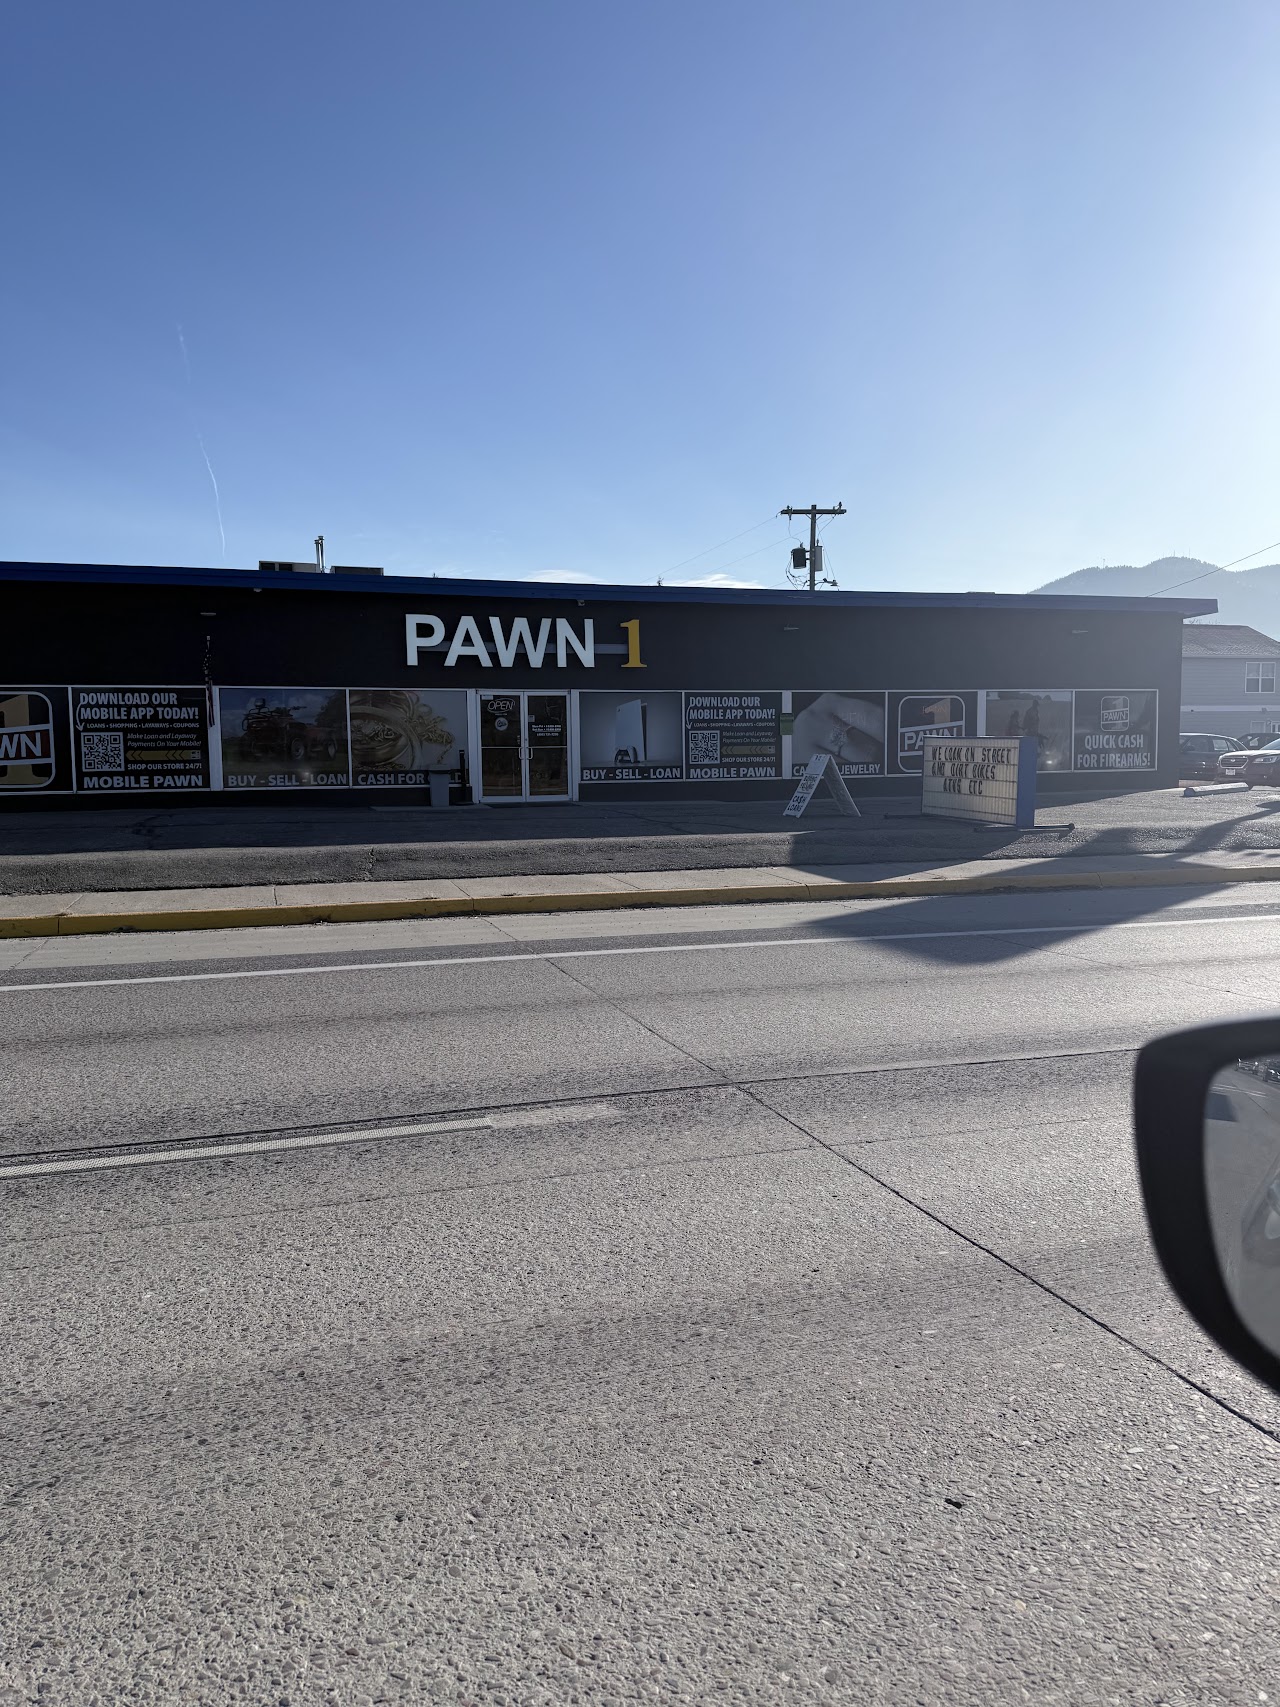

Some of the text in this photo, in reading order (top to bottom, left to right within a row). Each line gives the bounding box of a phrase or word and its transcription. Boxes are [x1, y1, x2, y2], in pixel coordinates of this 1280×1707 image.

[405, 613, 648, 669] PAWN 1
[79, 692, 178, 705] DOWNLOAD OUR
[488, 700, 514, 710] OPEN
[689, 696, 761, 707] DOWNLOAD OUR
[80, 706, 199, 720] MOBILE APP TODAY!
[689, 708, 776, 720] MOBILE APP TODAY!
[1103, 711, 1126, 721] PAWN
[1084, 734, 1144, 751] QUICK CASH
[931, 747, 1011, 763] WE LOAN ON STREET
[1077, 753, 1151, 768] FOR FIREARMS!
[582, 769, 607, 780] BUY
[615, 768, 642, 779] SELL
[650, 767, 681, 778] LOAN
[689, 767, 776, 779] MOBILE PAWN
[841, 763, 881, 775] JEWELRY
[931, 762, 996, 779] AND DIRT BIKES
[83, 774, 203, 789] MOBILE PAWN
[227, 775, 257, 786] BUY
[268, 774, 299, 786] SELL
[310, 773, 347, 785] LOAN
[357, 773, 396, 785] CASH
[398, 773, 425, 784] FOR
[943, 778, 983, 795] ATVS ETC
